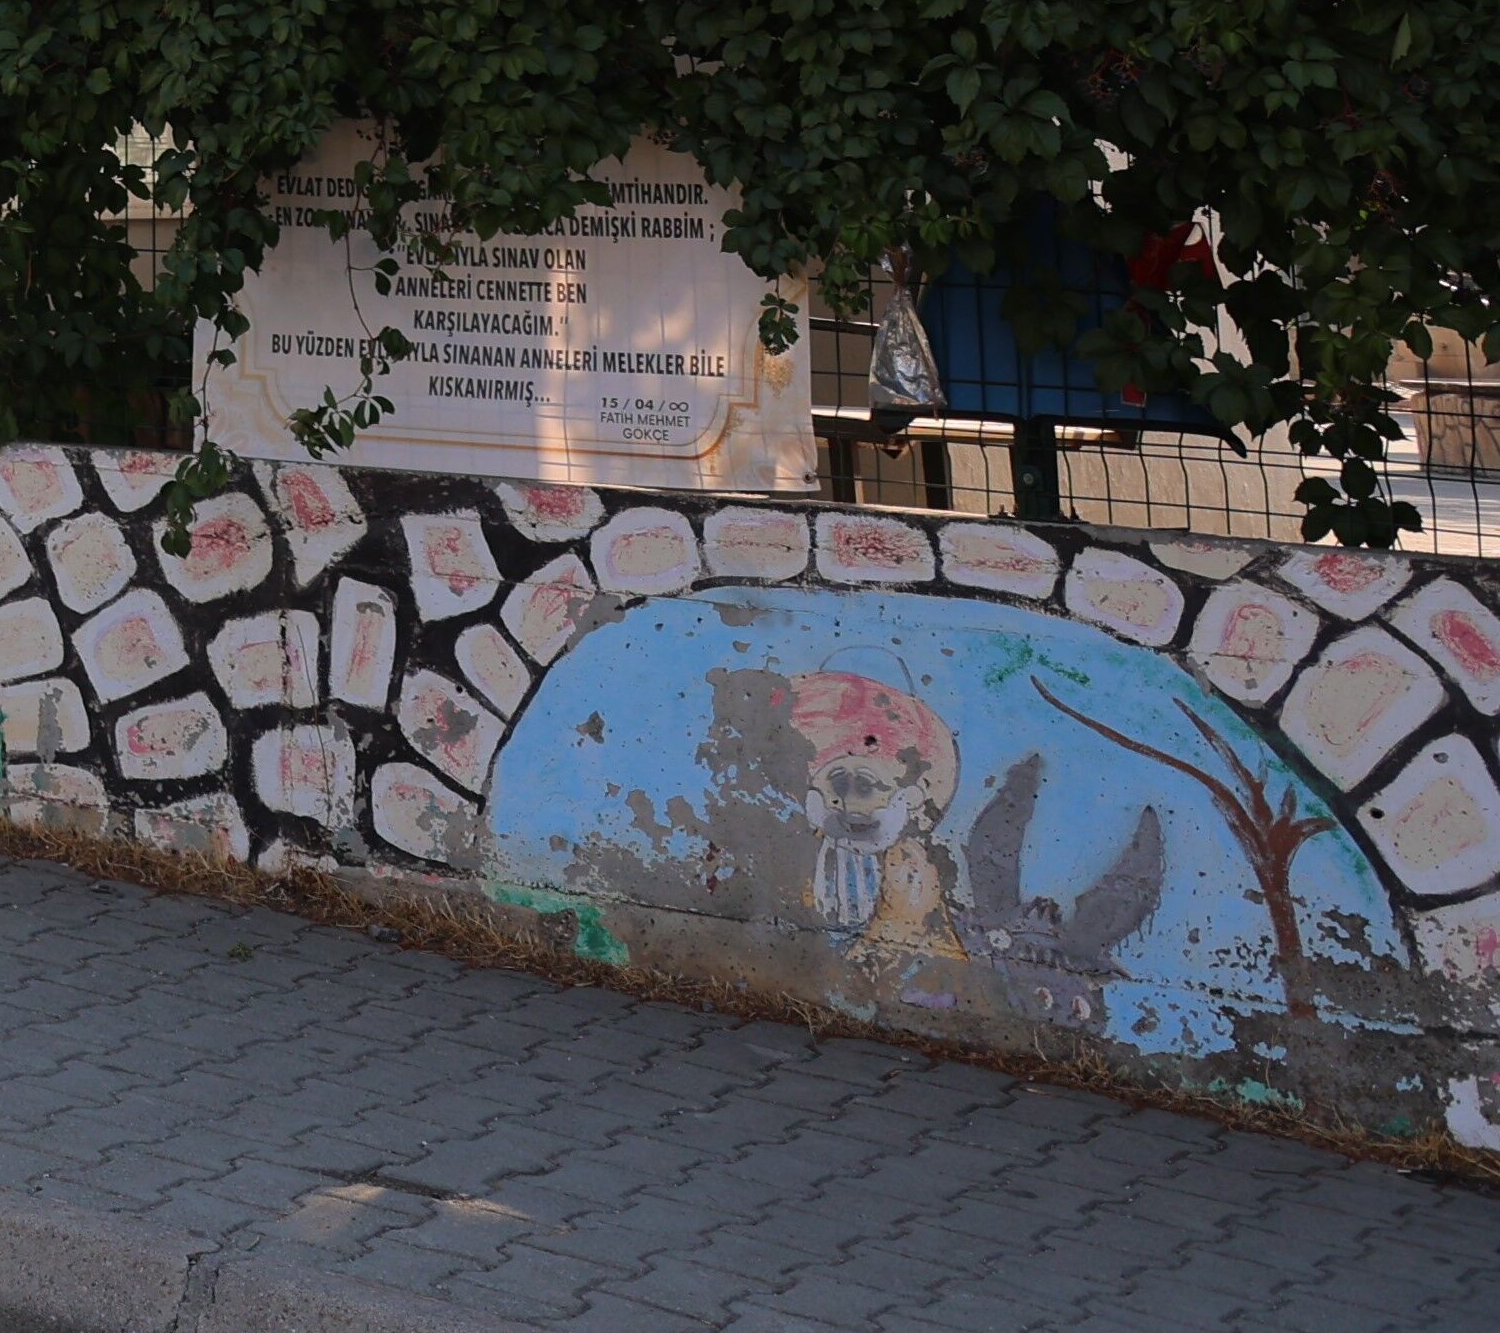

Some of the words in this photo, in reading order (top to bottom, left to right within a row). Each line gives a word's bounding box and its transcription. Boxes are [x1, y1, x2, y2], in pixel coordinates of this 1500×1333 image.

[277, 175, 322, 197] EVLAT
[275, 206, 292, 227] EN
[569, 211, 636, 244] DEMİŞKİ
[641, 212, 704, 239] RABBİM
[492, 246, 540, 269] SINAV
[544, 248, 587, 271] OLAN
[395, 273, 472, 300] ANNELERİ
[476, 279, 552, 303] CENNETTE
[556, 283, 587, 304] BEN
[271, 333, 292, 354] BU
[296, 330, 354, 358] YÜZDEN
[443, 343, 516, 368] SINANAN
[520, 345, 598, 373] ANNELERİ
[602, 350, 685, 376] MELEKLER
[689, 349, 726, 377] BİLE
[601, 397, 618, 409] 15
[635, 398, 654, 411] 04
[637, 414, 691, 428] MEHMET
